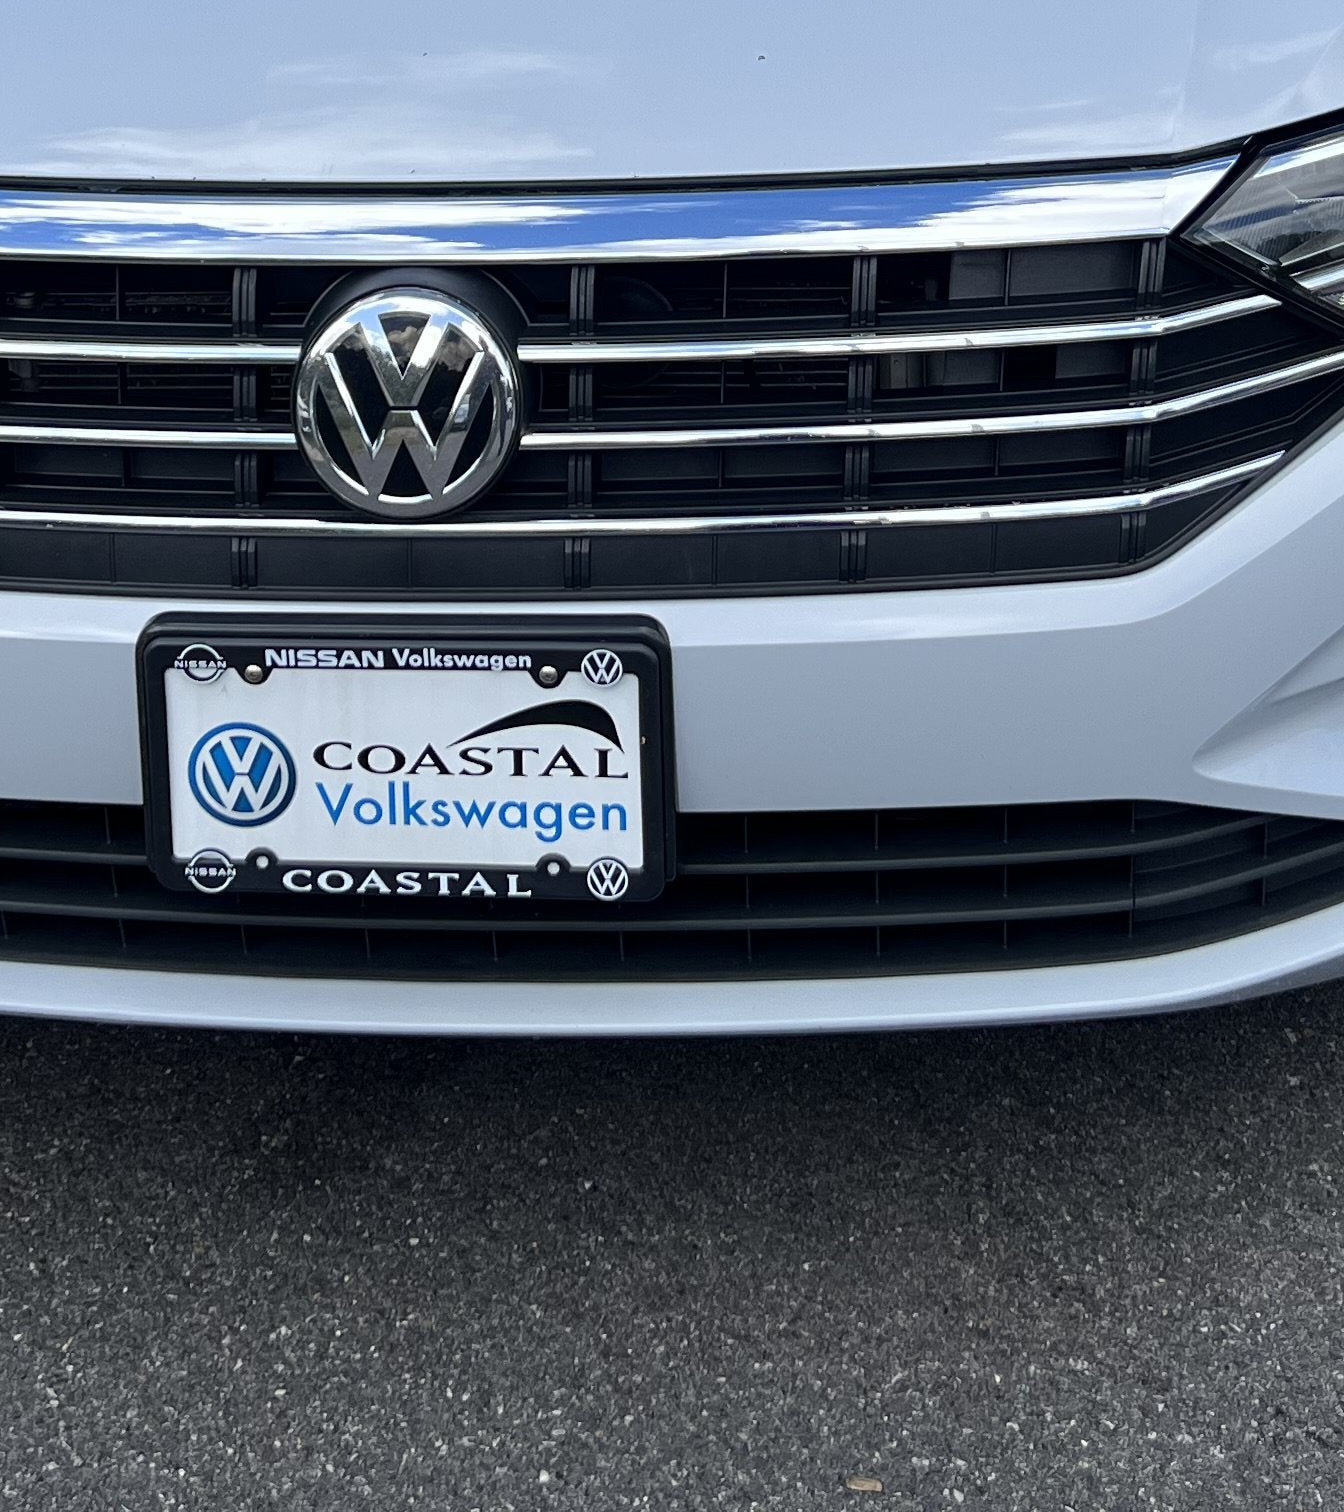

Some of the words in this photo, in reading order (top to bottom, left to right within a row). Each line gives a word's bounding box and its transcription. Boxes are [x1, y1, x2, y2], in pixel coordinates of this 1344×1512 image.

[174, 659, 227, 669] NISSAN
[264, 648, 385, 668] NISSAN
[391, 647, 532, 672] Volkswagen
[312, 740, 629, 779] COASTAL
[314, 780, 628, 843] Volkswagen
[184, 867, 237, 877] NISSAN
[282, 868, 532, 898] COASTAL
